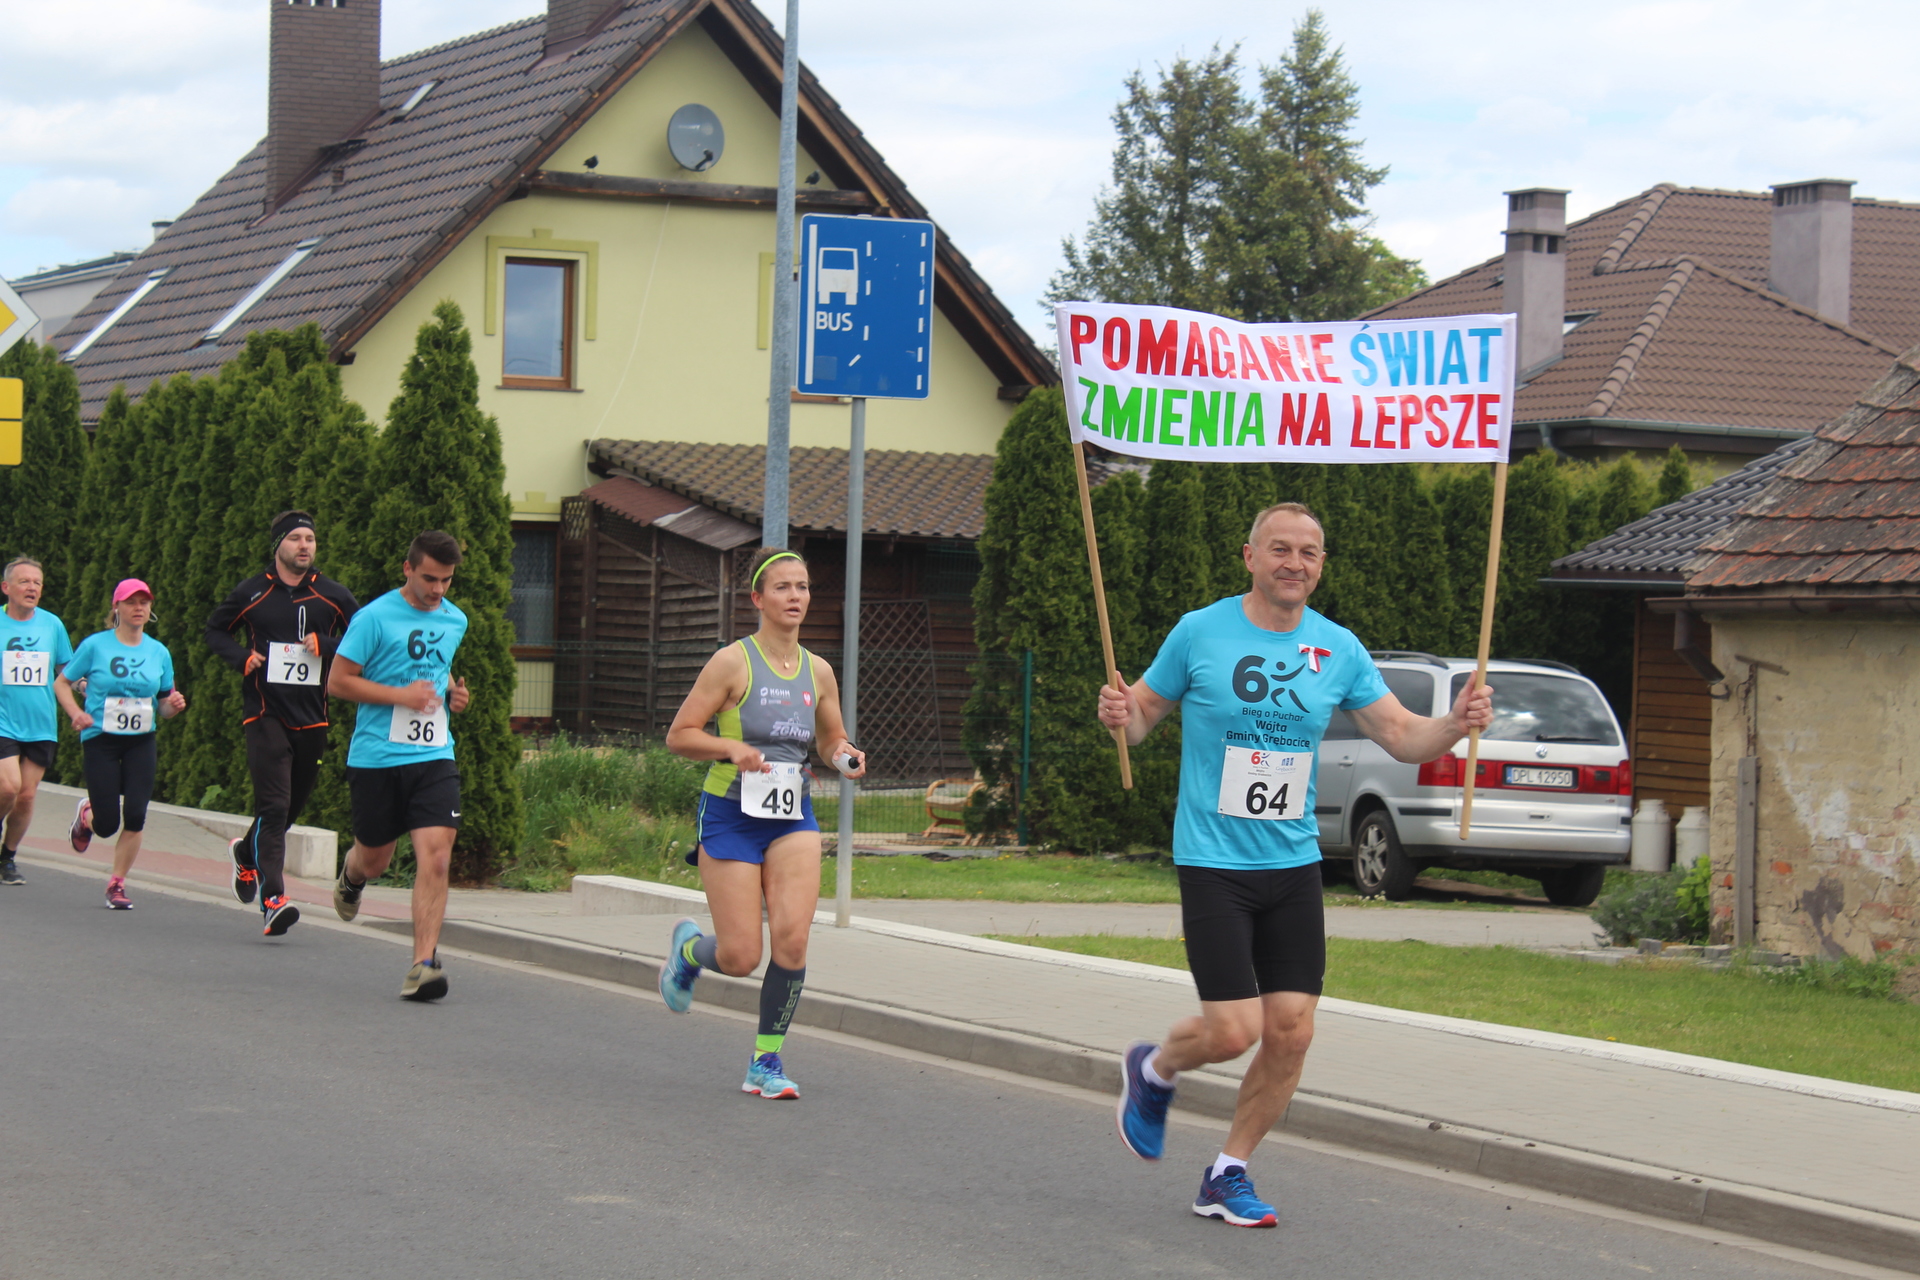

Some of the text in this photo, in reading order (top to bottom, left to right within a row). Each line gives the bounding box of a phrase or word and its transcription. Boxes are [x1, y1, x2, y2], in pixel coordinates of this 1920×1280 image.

[816, 310, 854, 331] BUS
[1070, 314, 1503, 387] POMAGANIE ŚWIAT
[1078, 376, 1501, 449] ZMIENIA NA LEPSZE
[407, 629, 427, 661] 6
[10, 666, 42, 684] 101
[109, 656, 129, 679] 6
[283, 662, 309, 682] 79
[1232, 655, 1269, 704] 6
[117, 713, 142, 731] 96
[1242, 707, 1262, 719] Bieg
[1272, 711, 1304, 722] Puchar
[407, 719, 435, 743] 36
[1255, 719, 1288, 733] Wójta
[1226, 731, 1311, 748] Gminy Grębocice
[1251, 751, 1261, 765] 6
[1512, 769, 1571, 785] DPL 12950
[761, 787, 794, 815] 49
[1245, 781, 1289, 816] 64
